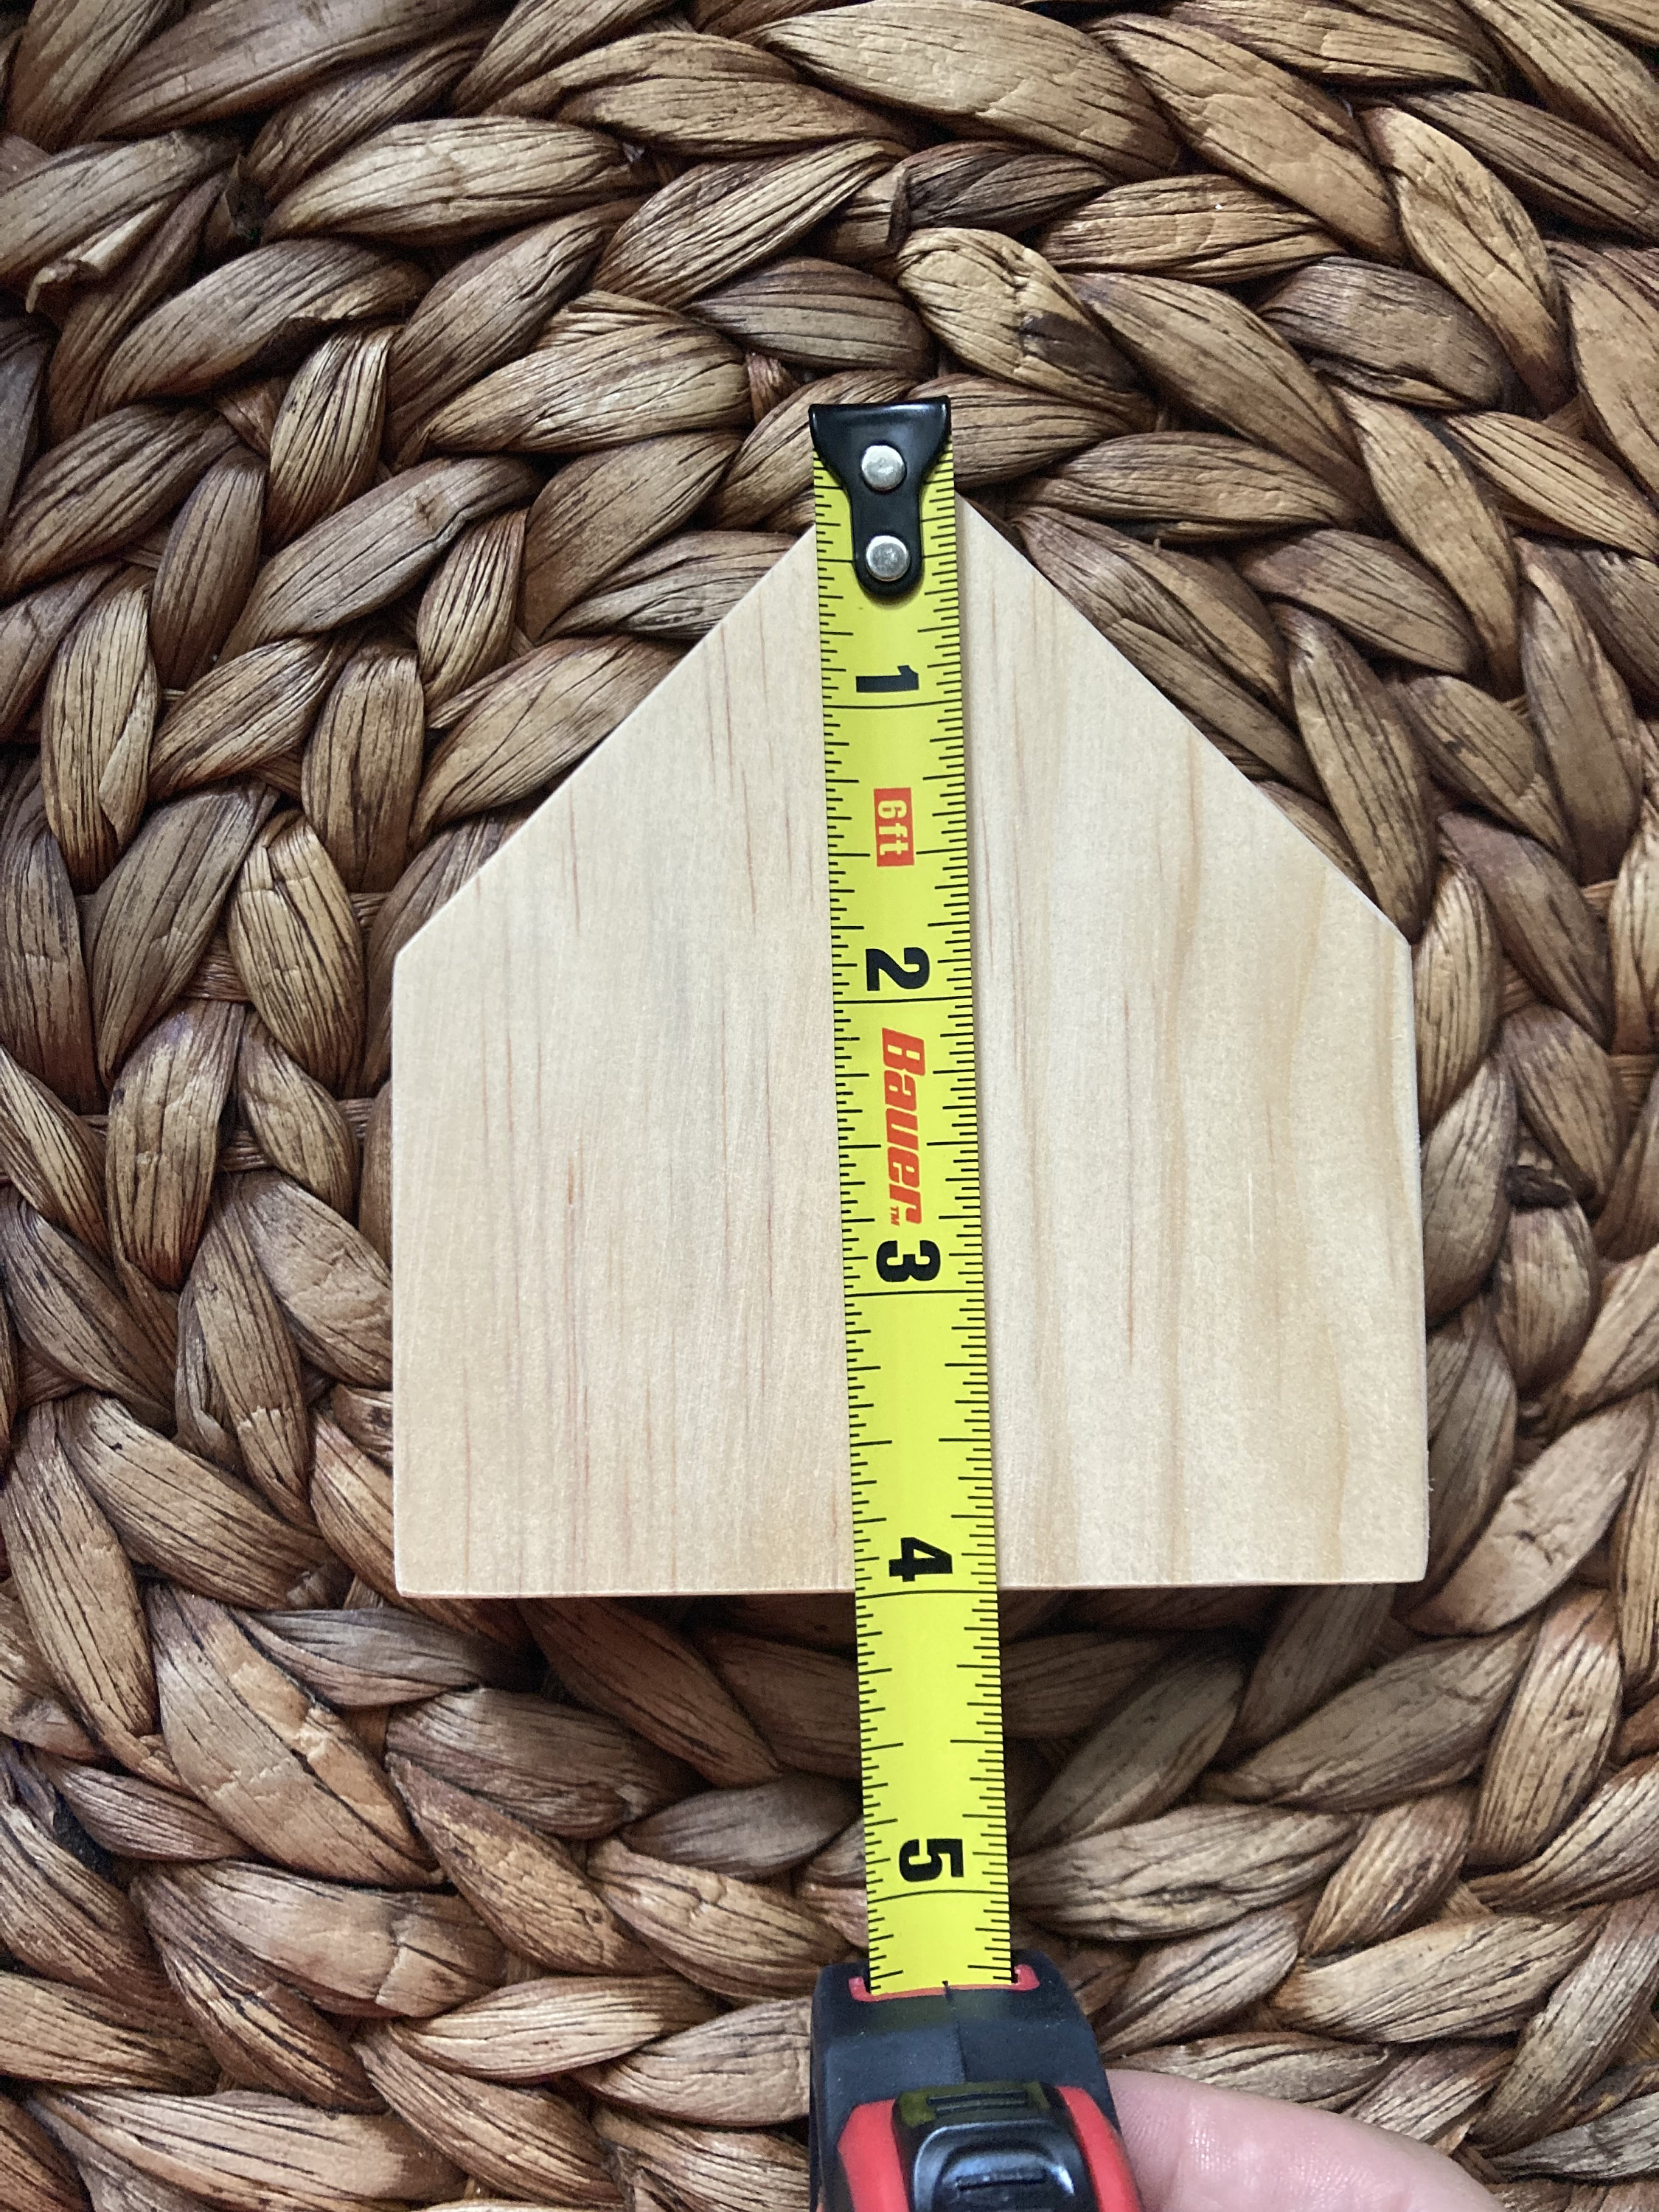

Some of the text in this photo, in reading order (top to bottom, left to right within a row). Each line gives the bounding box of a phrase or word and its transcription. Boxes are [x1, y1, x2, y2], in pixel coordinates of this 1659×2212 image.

[856, 665, 919, 692] 1
[878, 800, 908, 855] 6ft
[866, 947, 930, 991] 2
[883, 1027, 925, 1224] Bauer
[876, 1240, 941, 1282] 3
[888, 1537, 953, 1582] 4
[899, 1838, 964, 1882] 5
